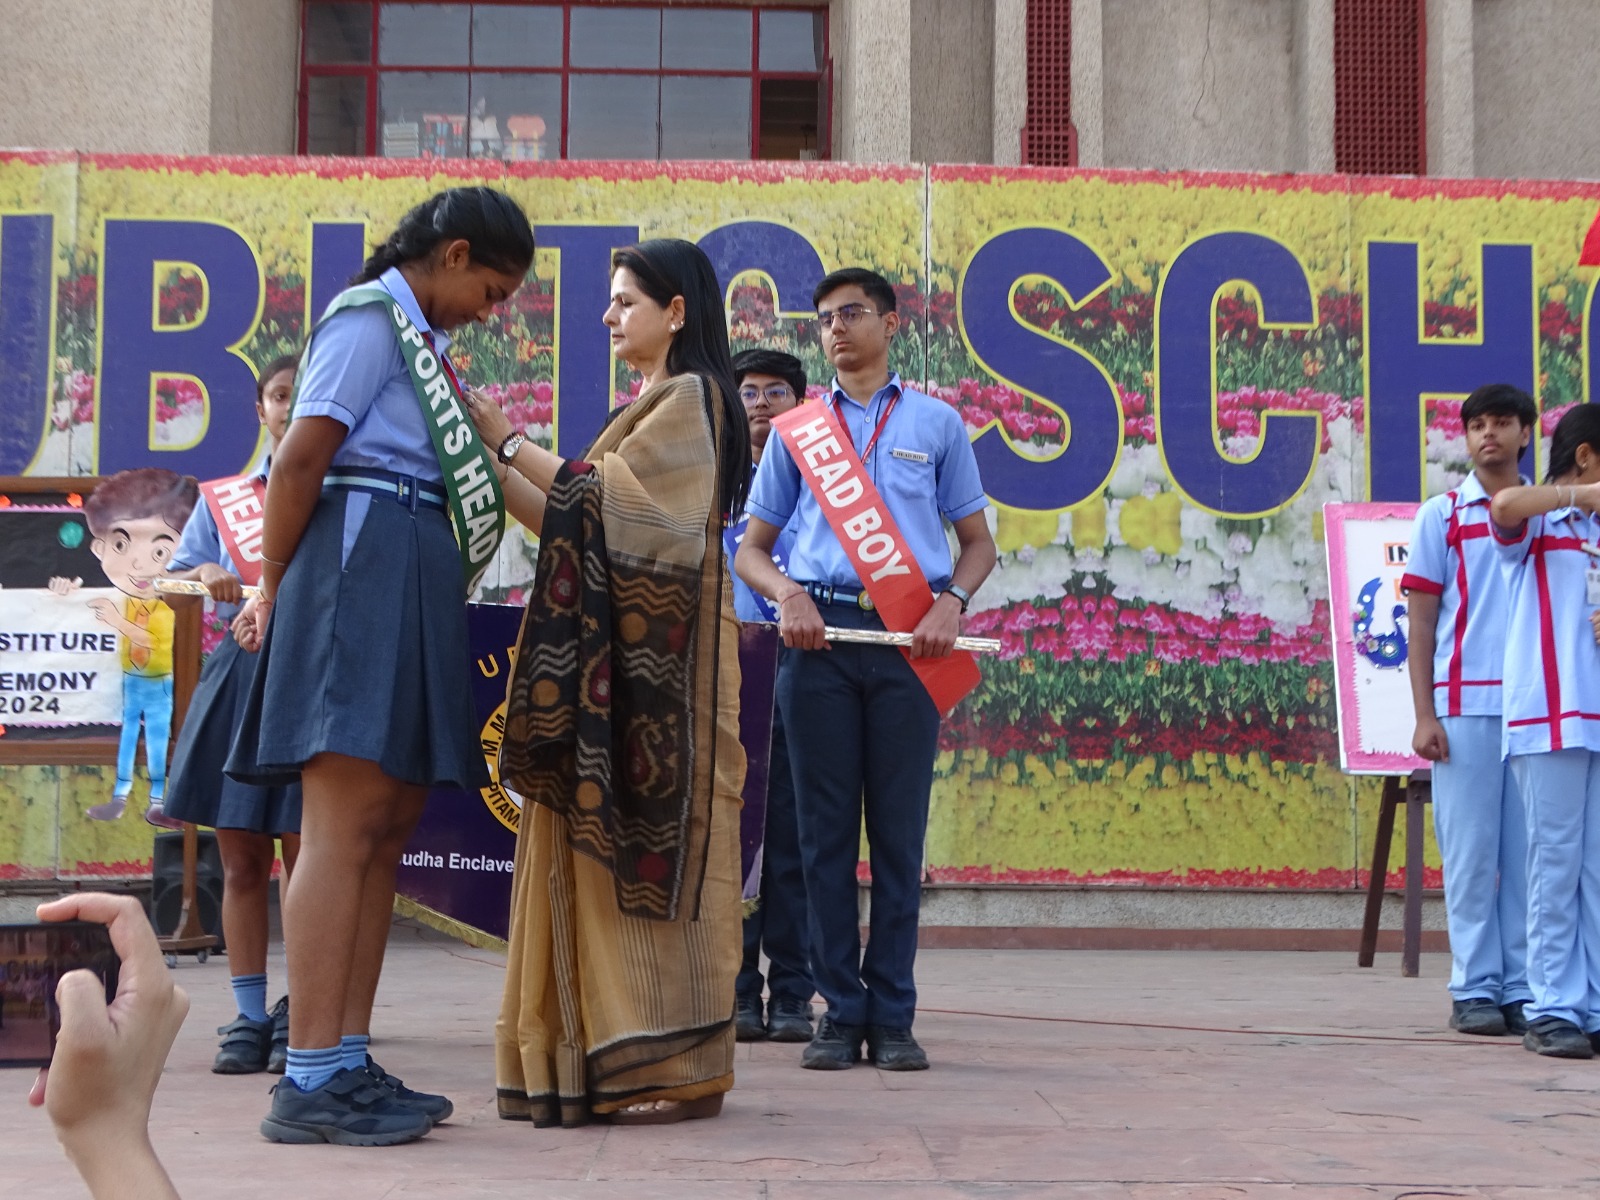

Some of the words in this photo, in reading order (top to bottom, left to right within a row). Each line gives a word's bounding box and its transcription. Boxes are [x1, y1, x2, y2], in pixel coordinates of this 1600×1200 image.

[392, 301, 472, 457] SPORTS
[453, 454, 499, 564] HEAD
[957, 226, 1600, 520] SCH
[212, 479, 264, 563] HEAD
[791, 416, 864, 508] HEAD
[842, 506, 911, 582] BOY
[399, 850, 443, 868] udha
[449, 852, 515, 873] Enclave
[488, 781, 521, 829] PITAM
